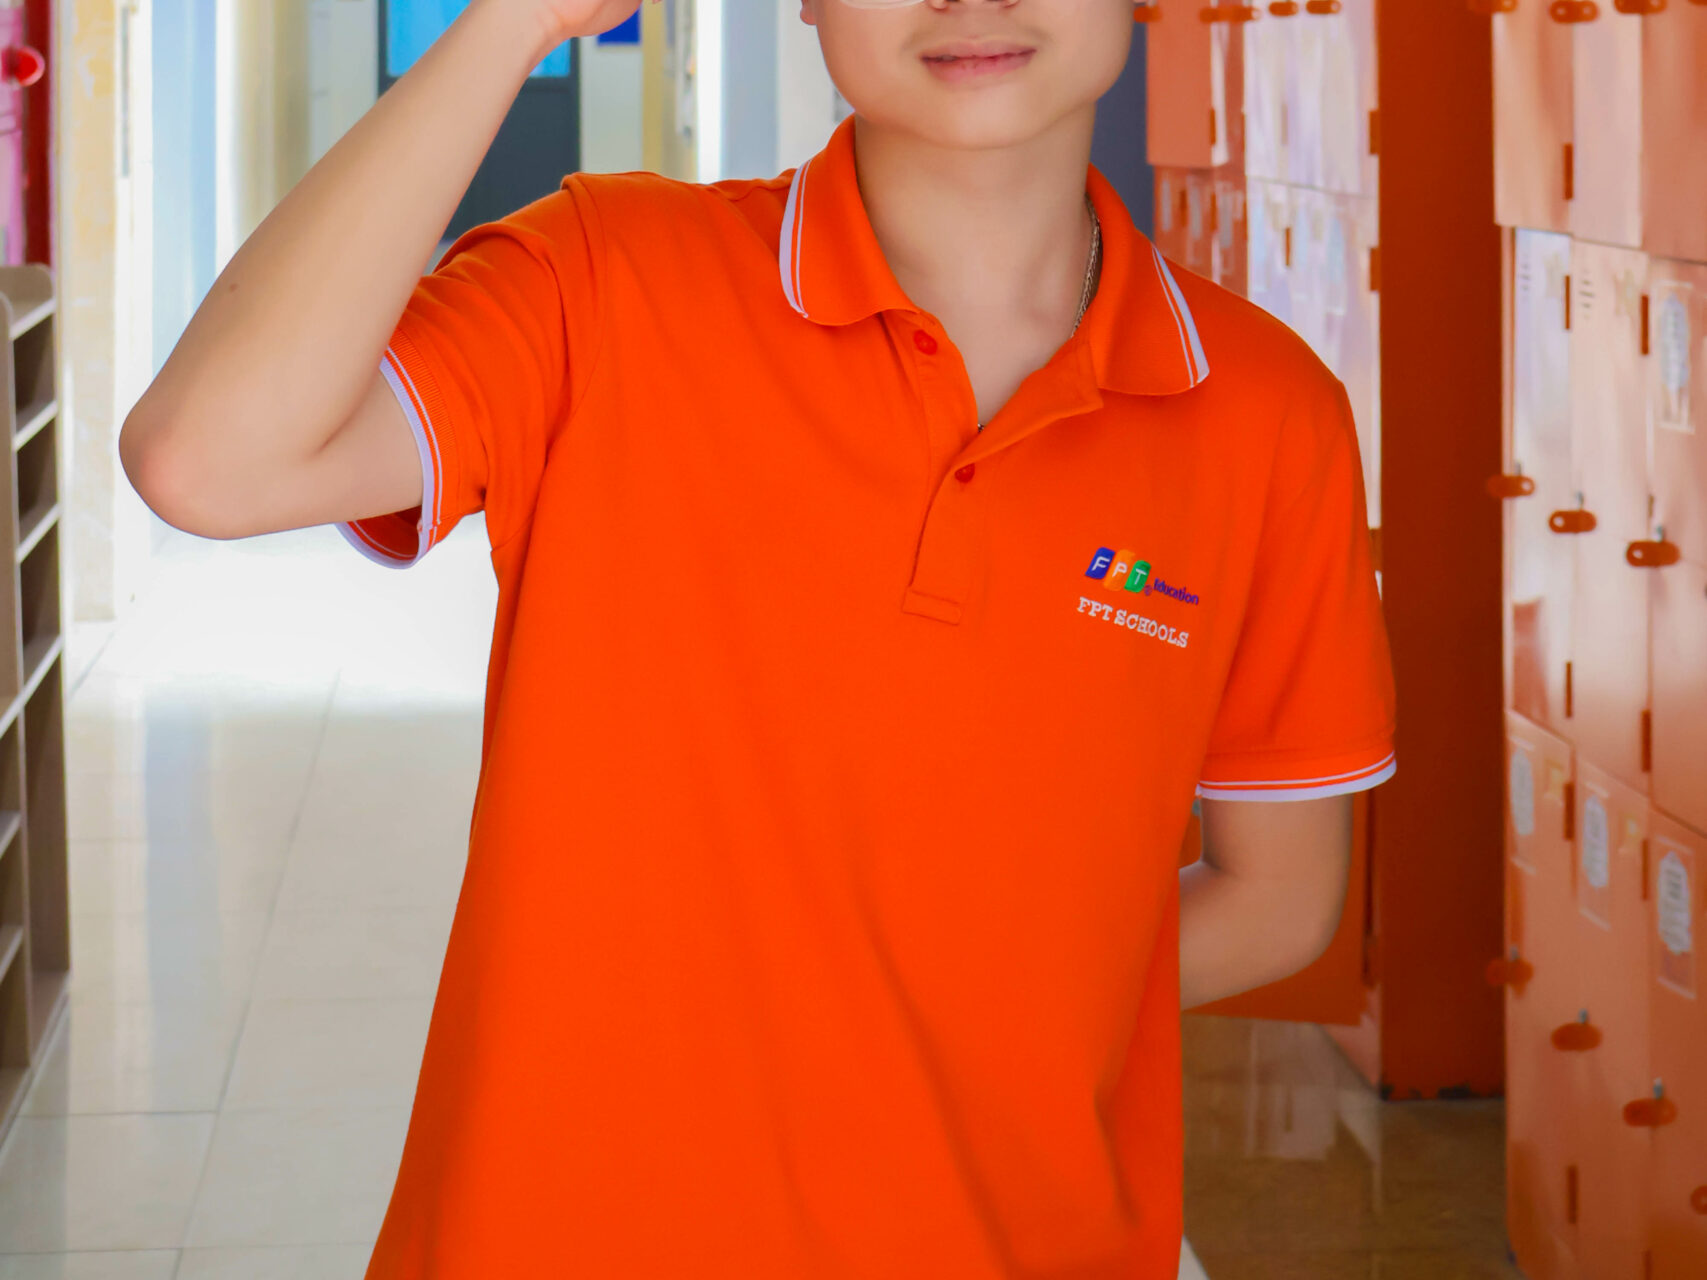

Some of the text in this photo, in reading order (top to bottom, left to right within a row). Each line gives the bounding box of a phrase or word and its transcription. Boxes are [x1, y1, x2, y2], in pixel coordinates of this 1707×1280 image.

[1153, 578, 1200, 606] Education
[1077, 596, 1190, 649] FPT SCHOOLS
